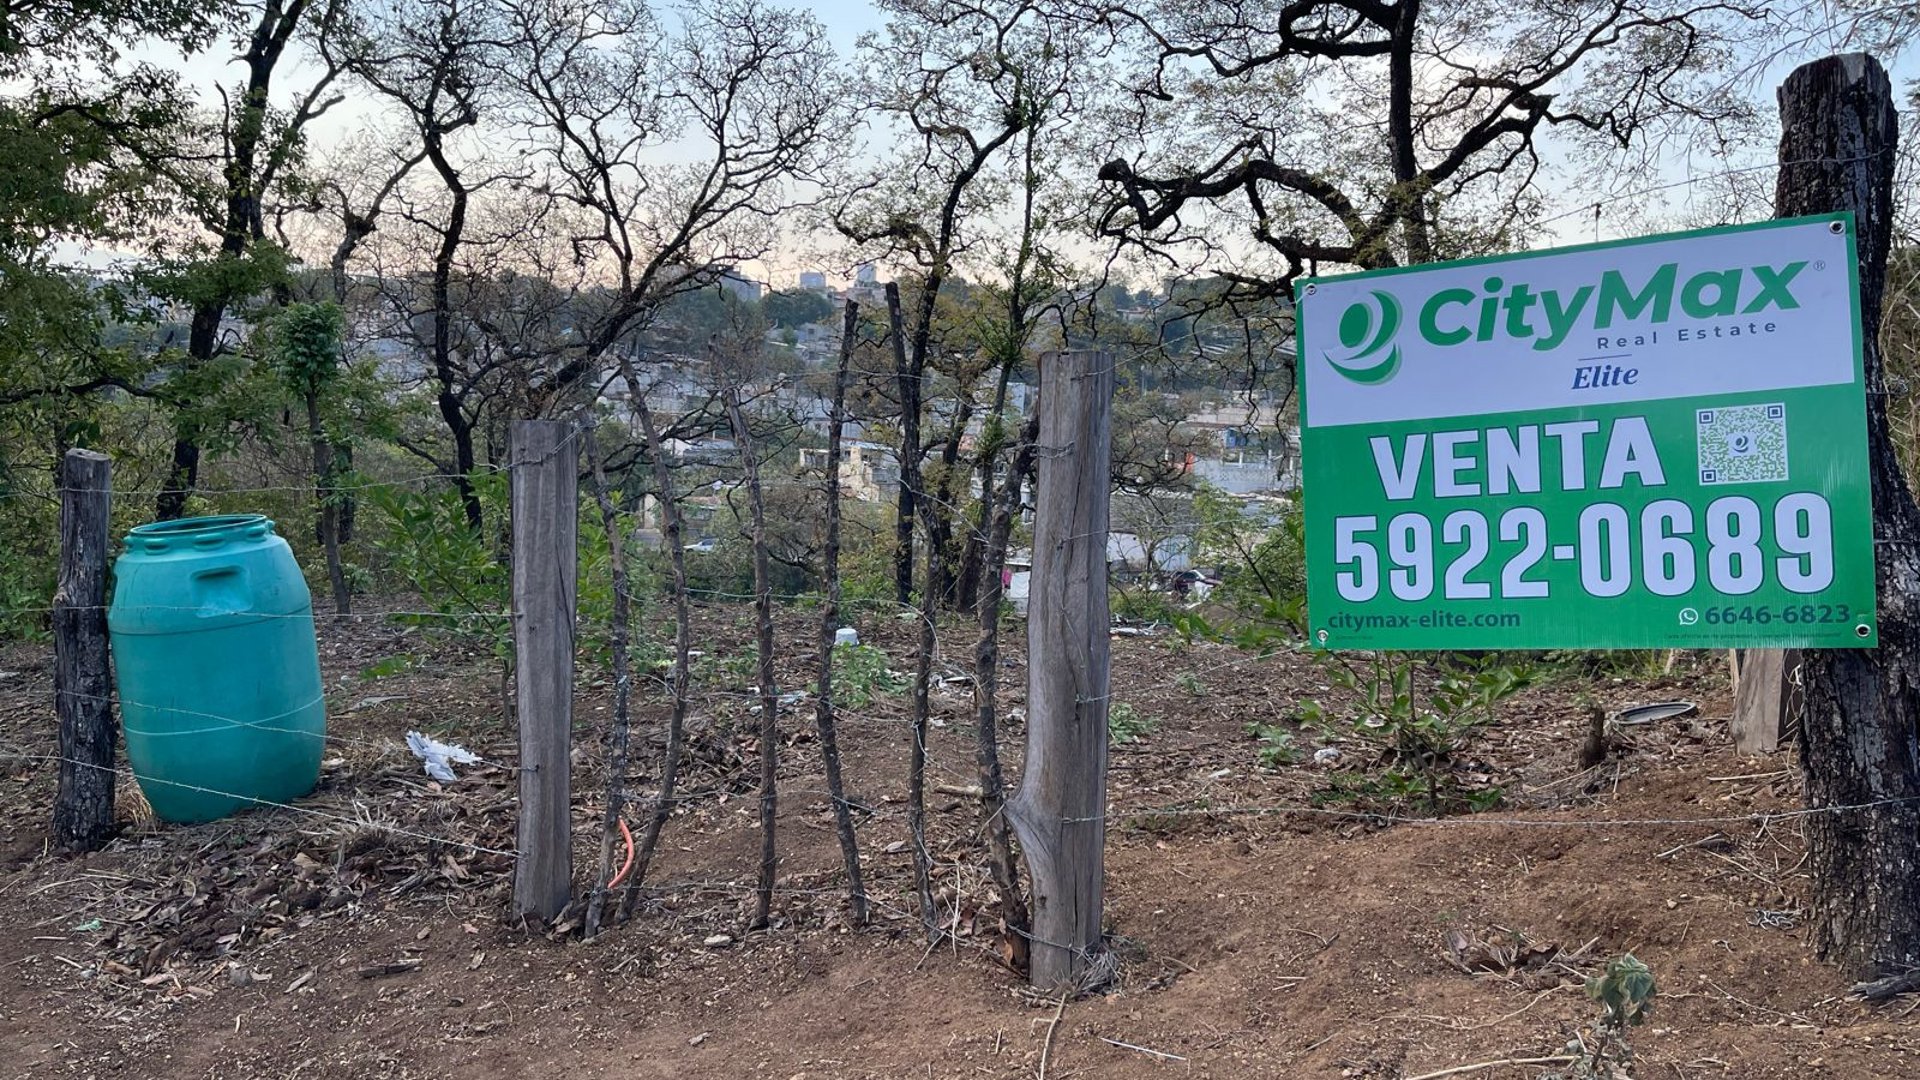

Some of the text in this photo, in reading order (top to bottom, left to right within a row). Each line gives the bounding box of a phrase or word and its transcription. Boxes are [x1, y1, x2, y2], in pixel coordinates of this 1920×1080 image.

[1418, 258, 1810, 352] CityMax
[1597, 321, 1776, 349] Real Estate
[1571, 364, 1639, 390] Elite
[1369, 416, 1667, 500] VENTA
[1335, 491, 1834, 602] 5922-0689
[1328, 610, 1521, 632] citymax-elite.com
[1704, 604, 1851, 625] 6646-6823
